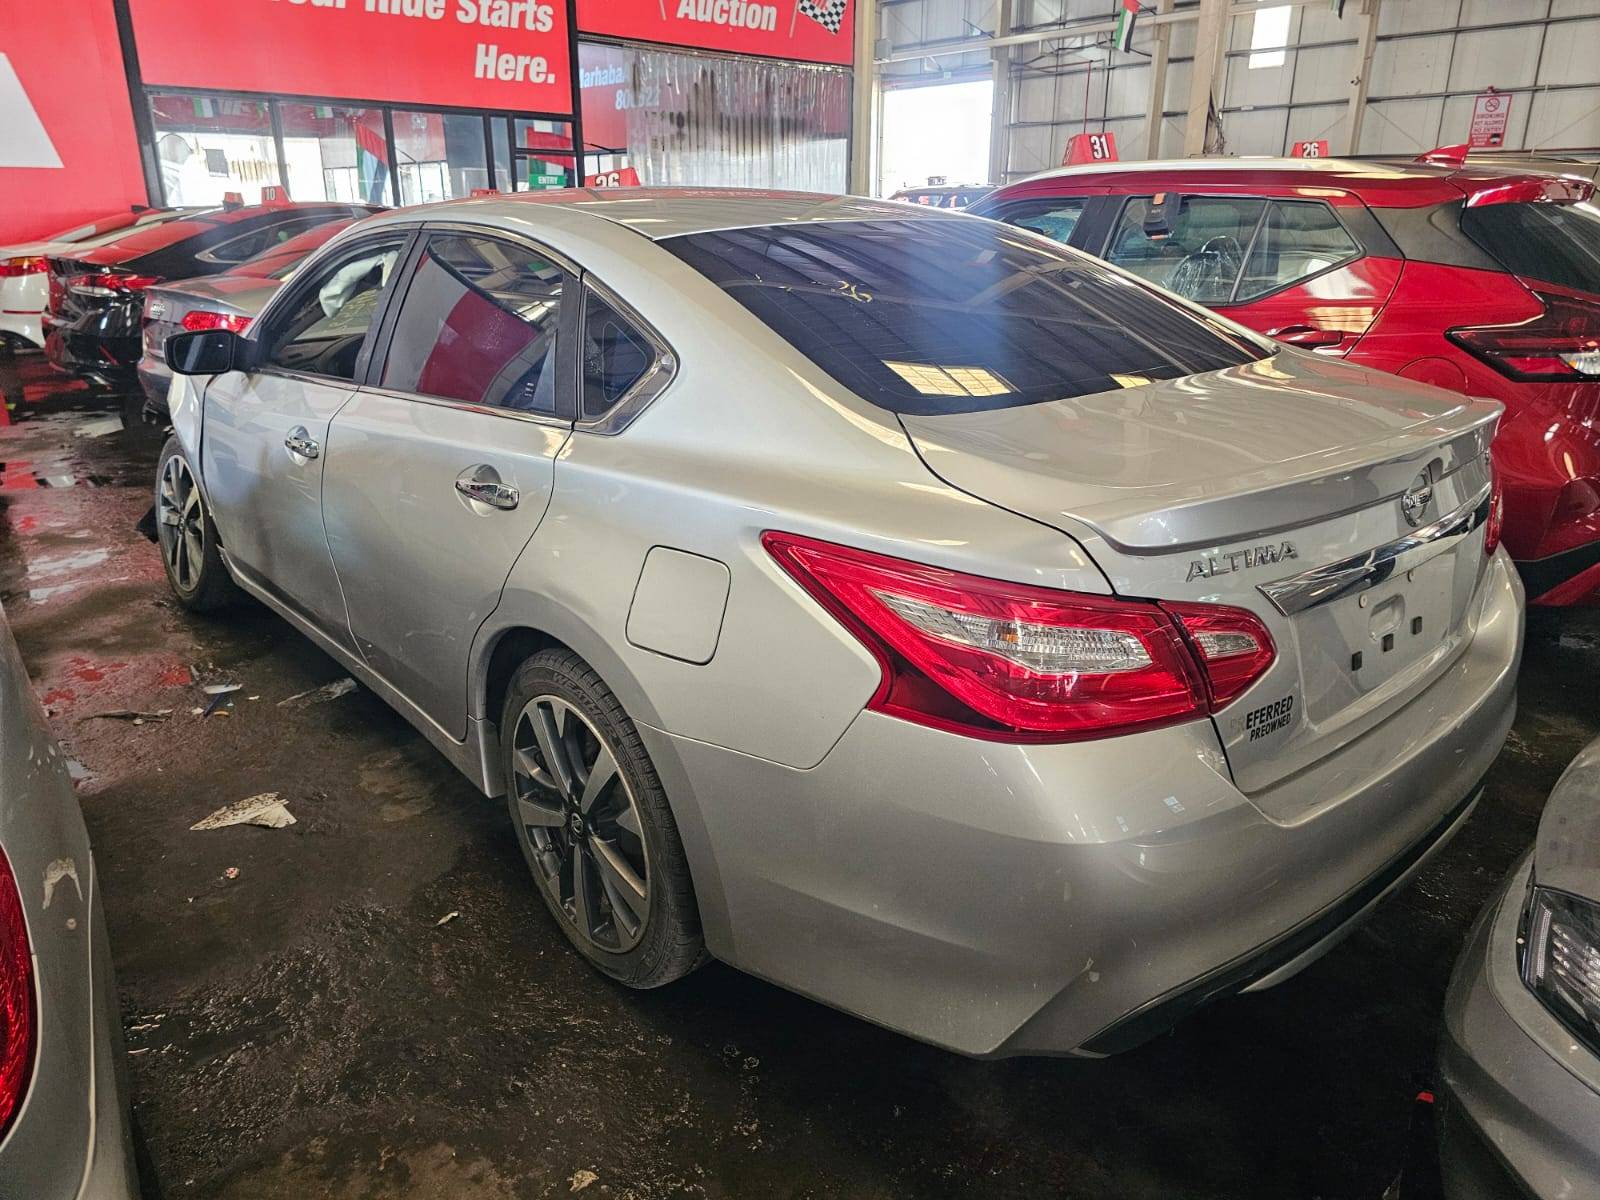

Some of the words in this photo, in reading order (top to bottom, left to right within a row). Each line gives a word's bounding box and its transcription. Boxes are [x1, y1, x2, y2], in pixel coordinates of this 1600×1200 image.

[456, 0, 554, 32] Starts
[676, 0, 778, 32] Auction
[474, 43, 556, 84] Here.
[1090, 134, 1110, 159] 31
[1302, 142, 1319, 158] 26
[265, 187, 277, 201] 10
[1185, 541, 1299, 583] ALTIMA
[1249, 713, 1291, 742] PREOWNED
